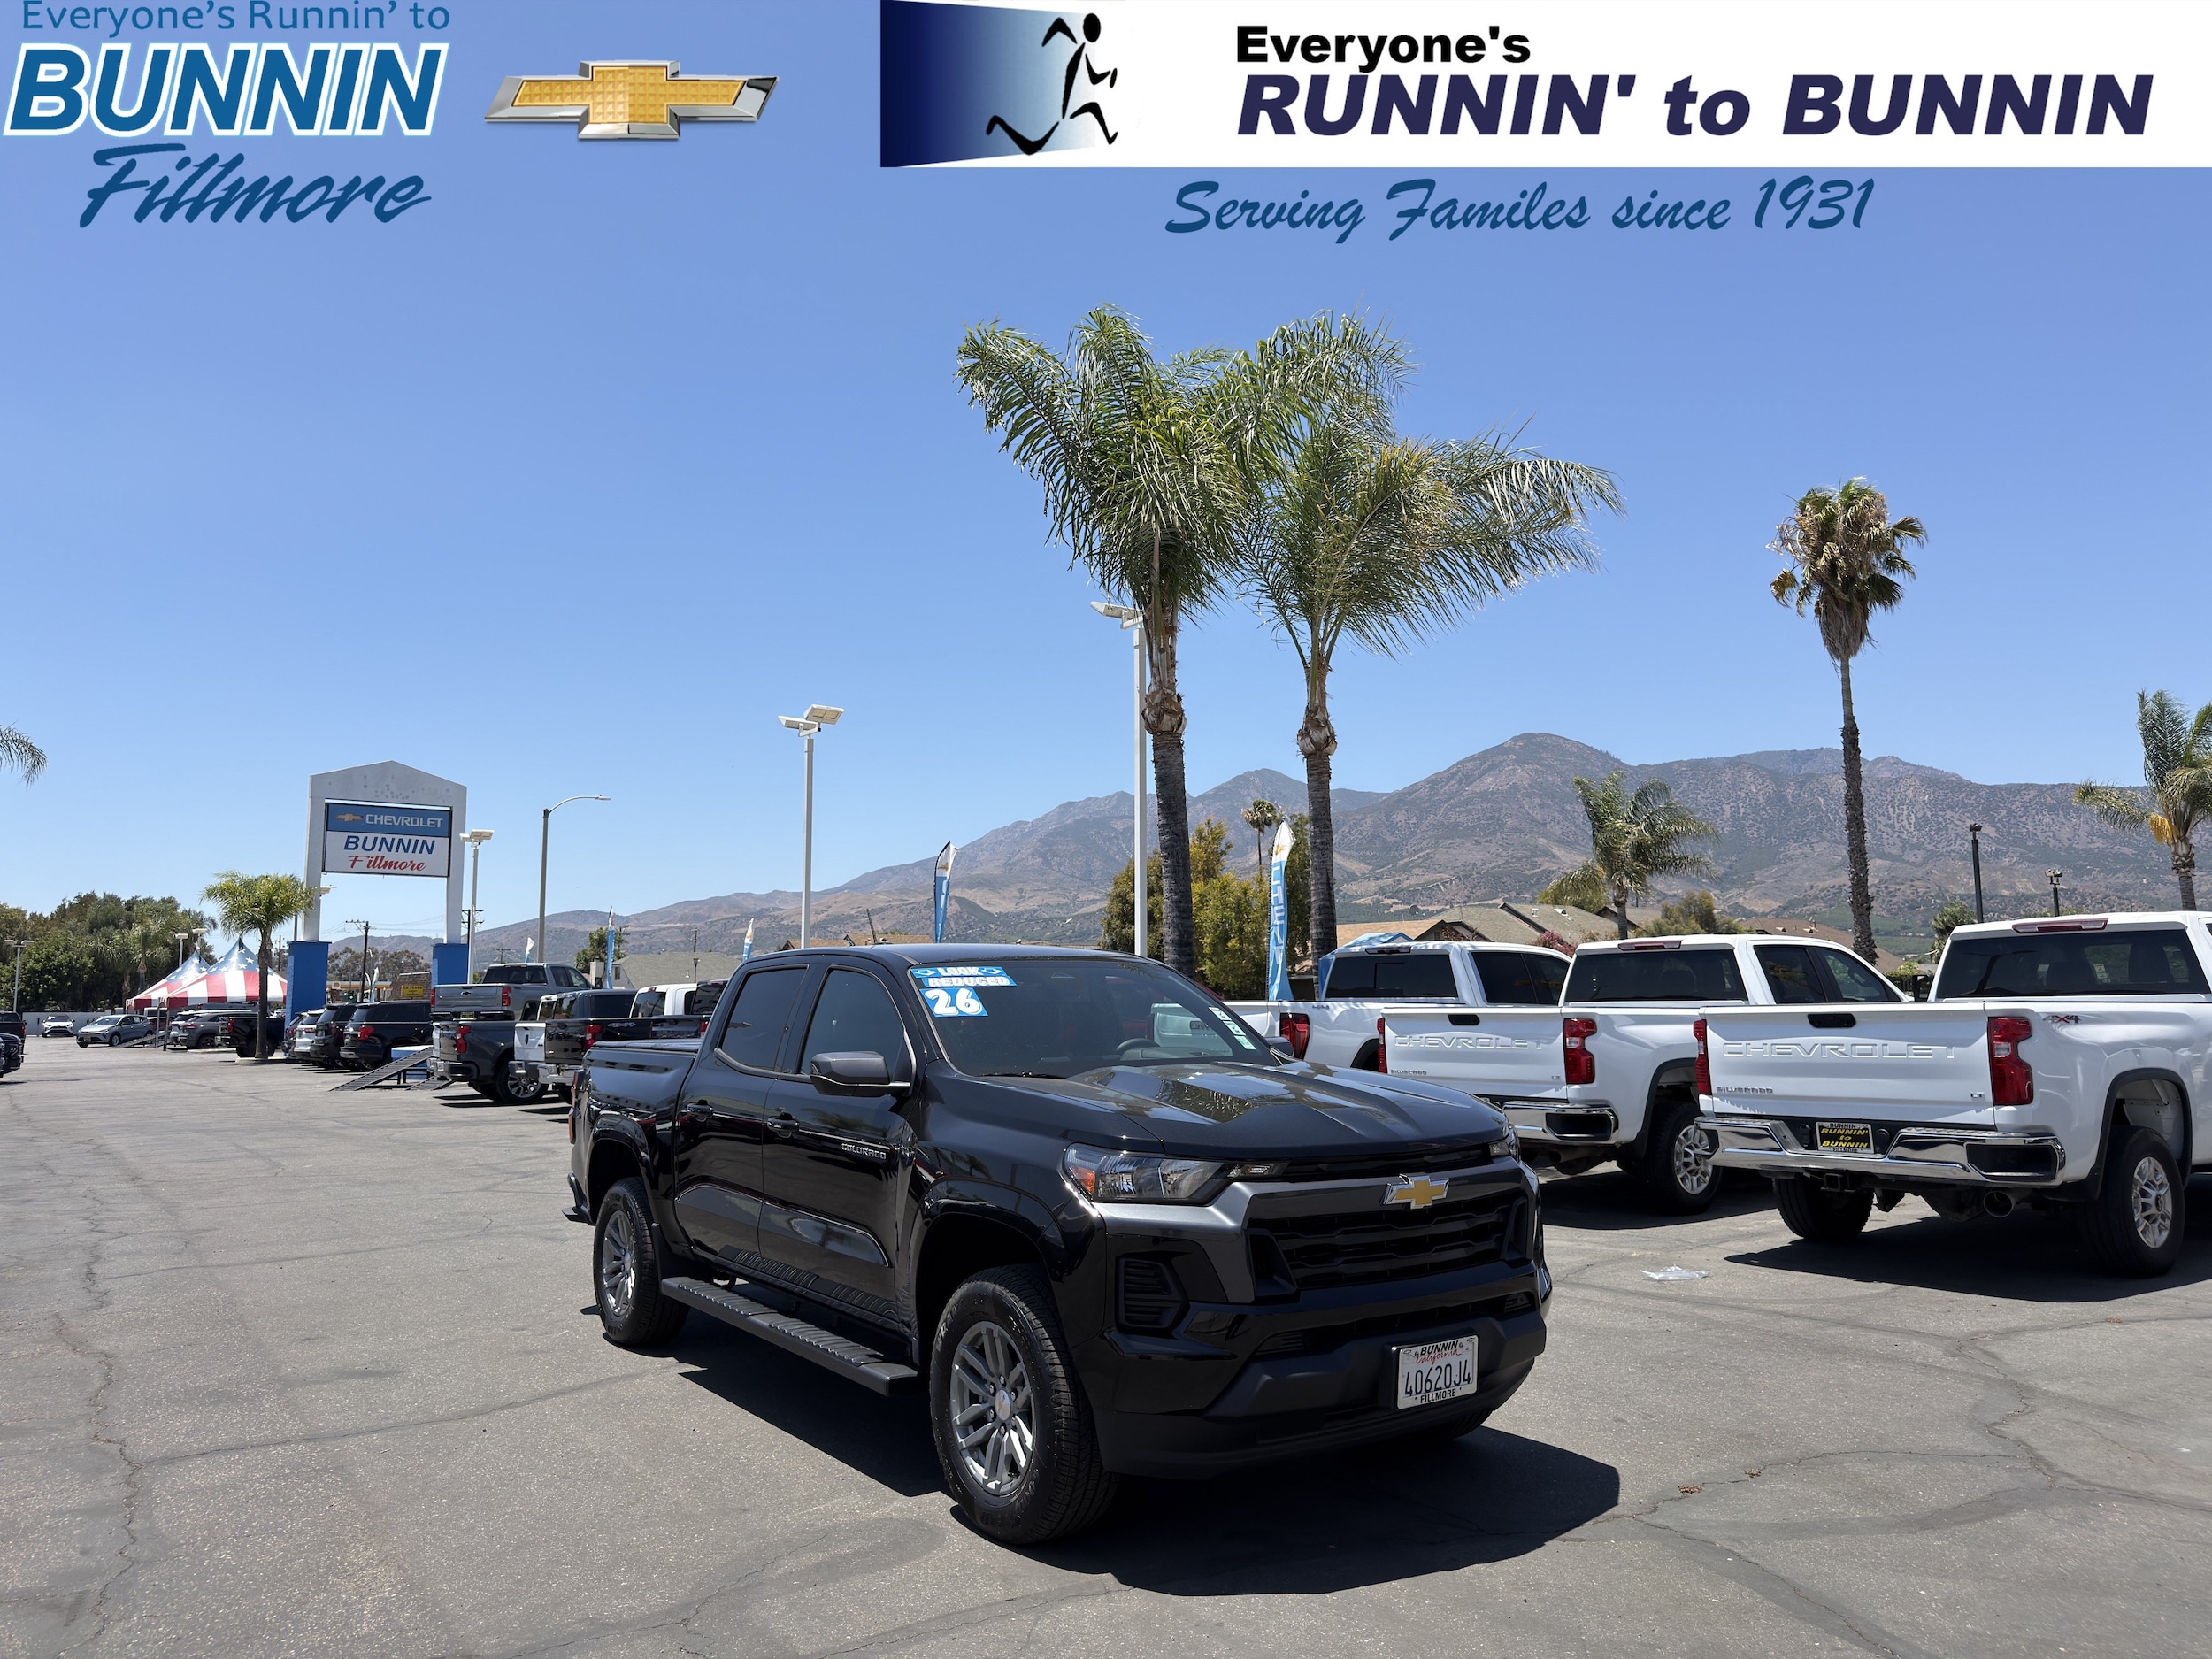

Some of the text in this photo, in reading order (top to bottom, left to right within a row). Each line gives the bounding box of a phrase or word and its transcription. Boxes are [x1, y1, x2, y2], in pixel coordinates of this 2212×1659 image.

[365, 813, 444, 828] CHEVROLET
[343, 834, 436, 855] BUNNIN
[348, 855, 426, 872] Fillmore
[937, 966, 984, 977] LOOK
[927, 976, 1010, 987] REDUCED
[924, 987, 983, 1016] 26
[1394, 1035, 1542, 1050] CHEVROLET
[1723, 1042, 1955, 1059] CHEVROLET
[841, 1143, 887, 1160] COLORADO
[1420, 1340, 1459, 1356] BUNNIN
[1416, 1349, 1462, 1365] California
[1405, 1359, 1471, 1396] 40620J4
[1420, 1388, 1456, 1404] FILLMORE
